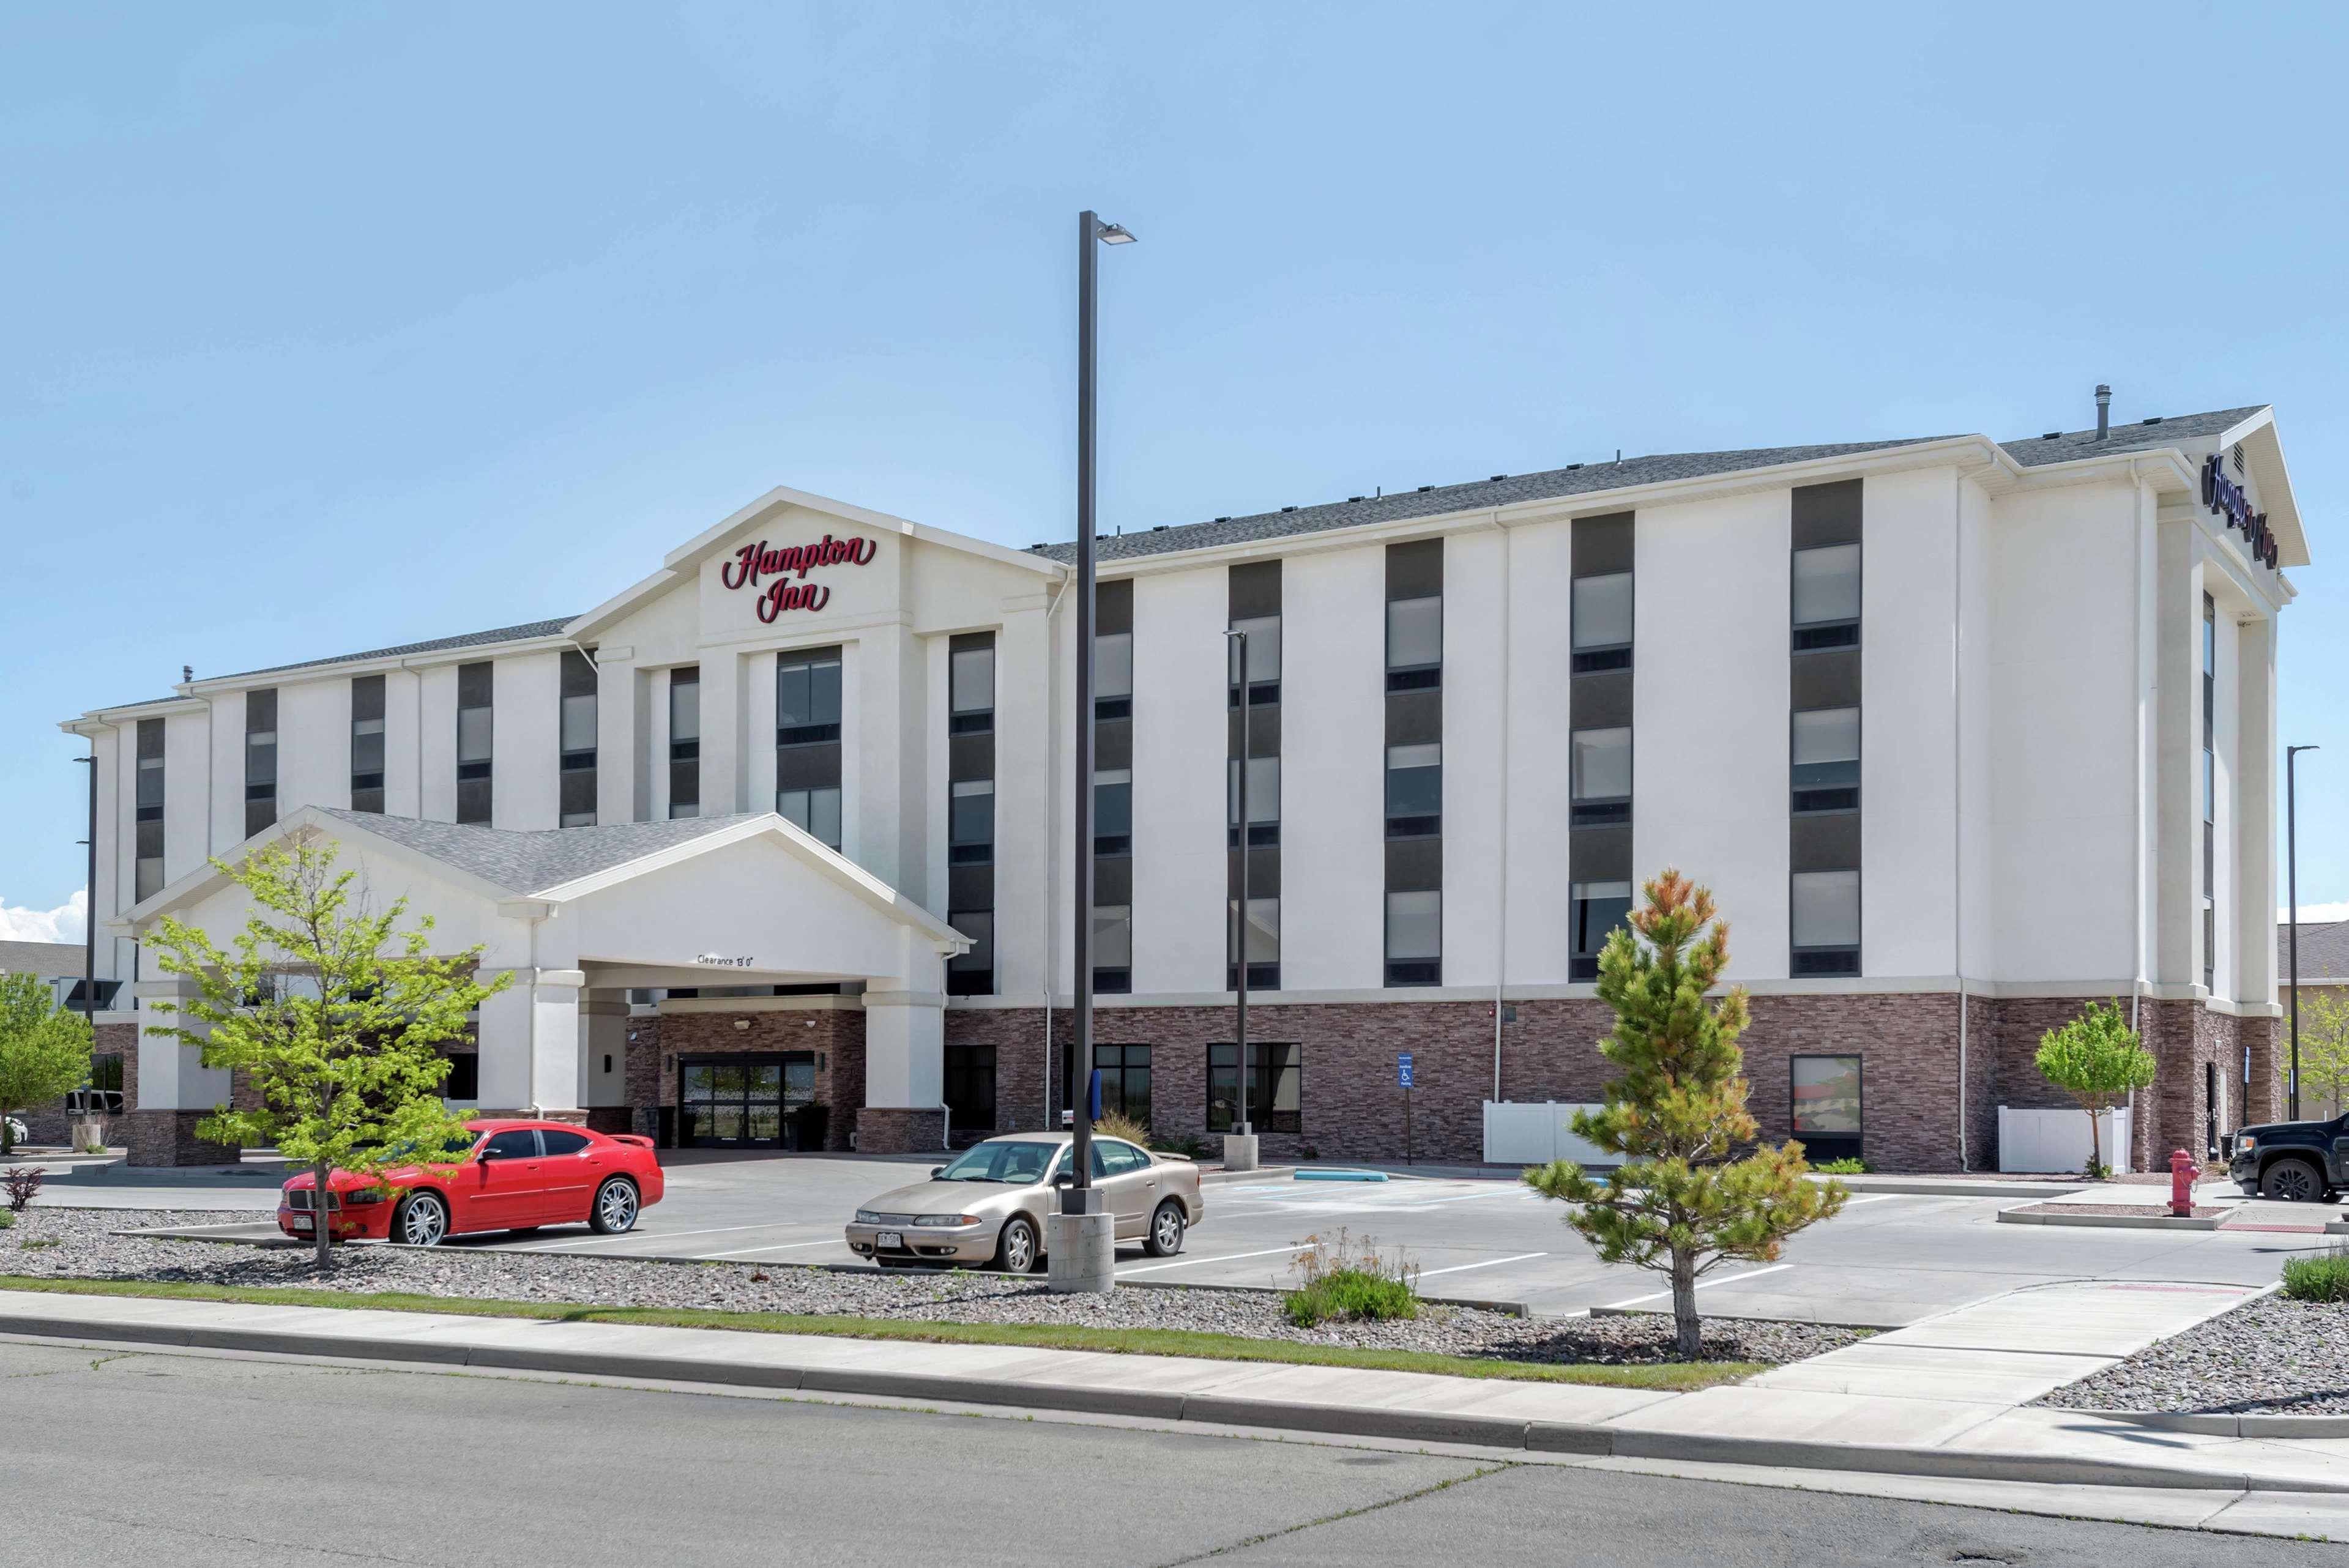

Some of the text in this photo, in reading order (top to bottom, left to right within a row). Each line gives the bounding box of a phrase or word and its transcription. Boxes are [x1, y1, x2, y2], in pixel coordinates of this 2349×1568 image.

[721, 534, 877, 590] Hampton
[756, 577, 830, 623] Inn
[698, 954, 734, 965] Clearance
